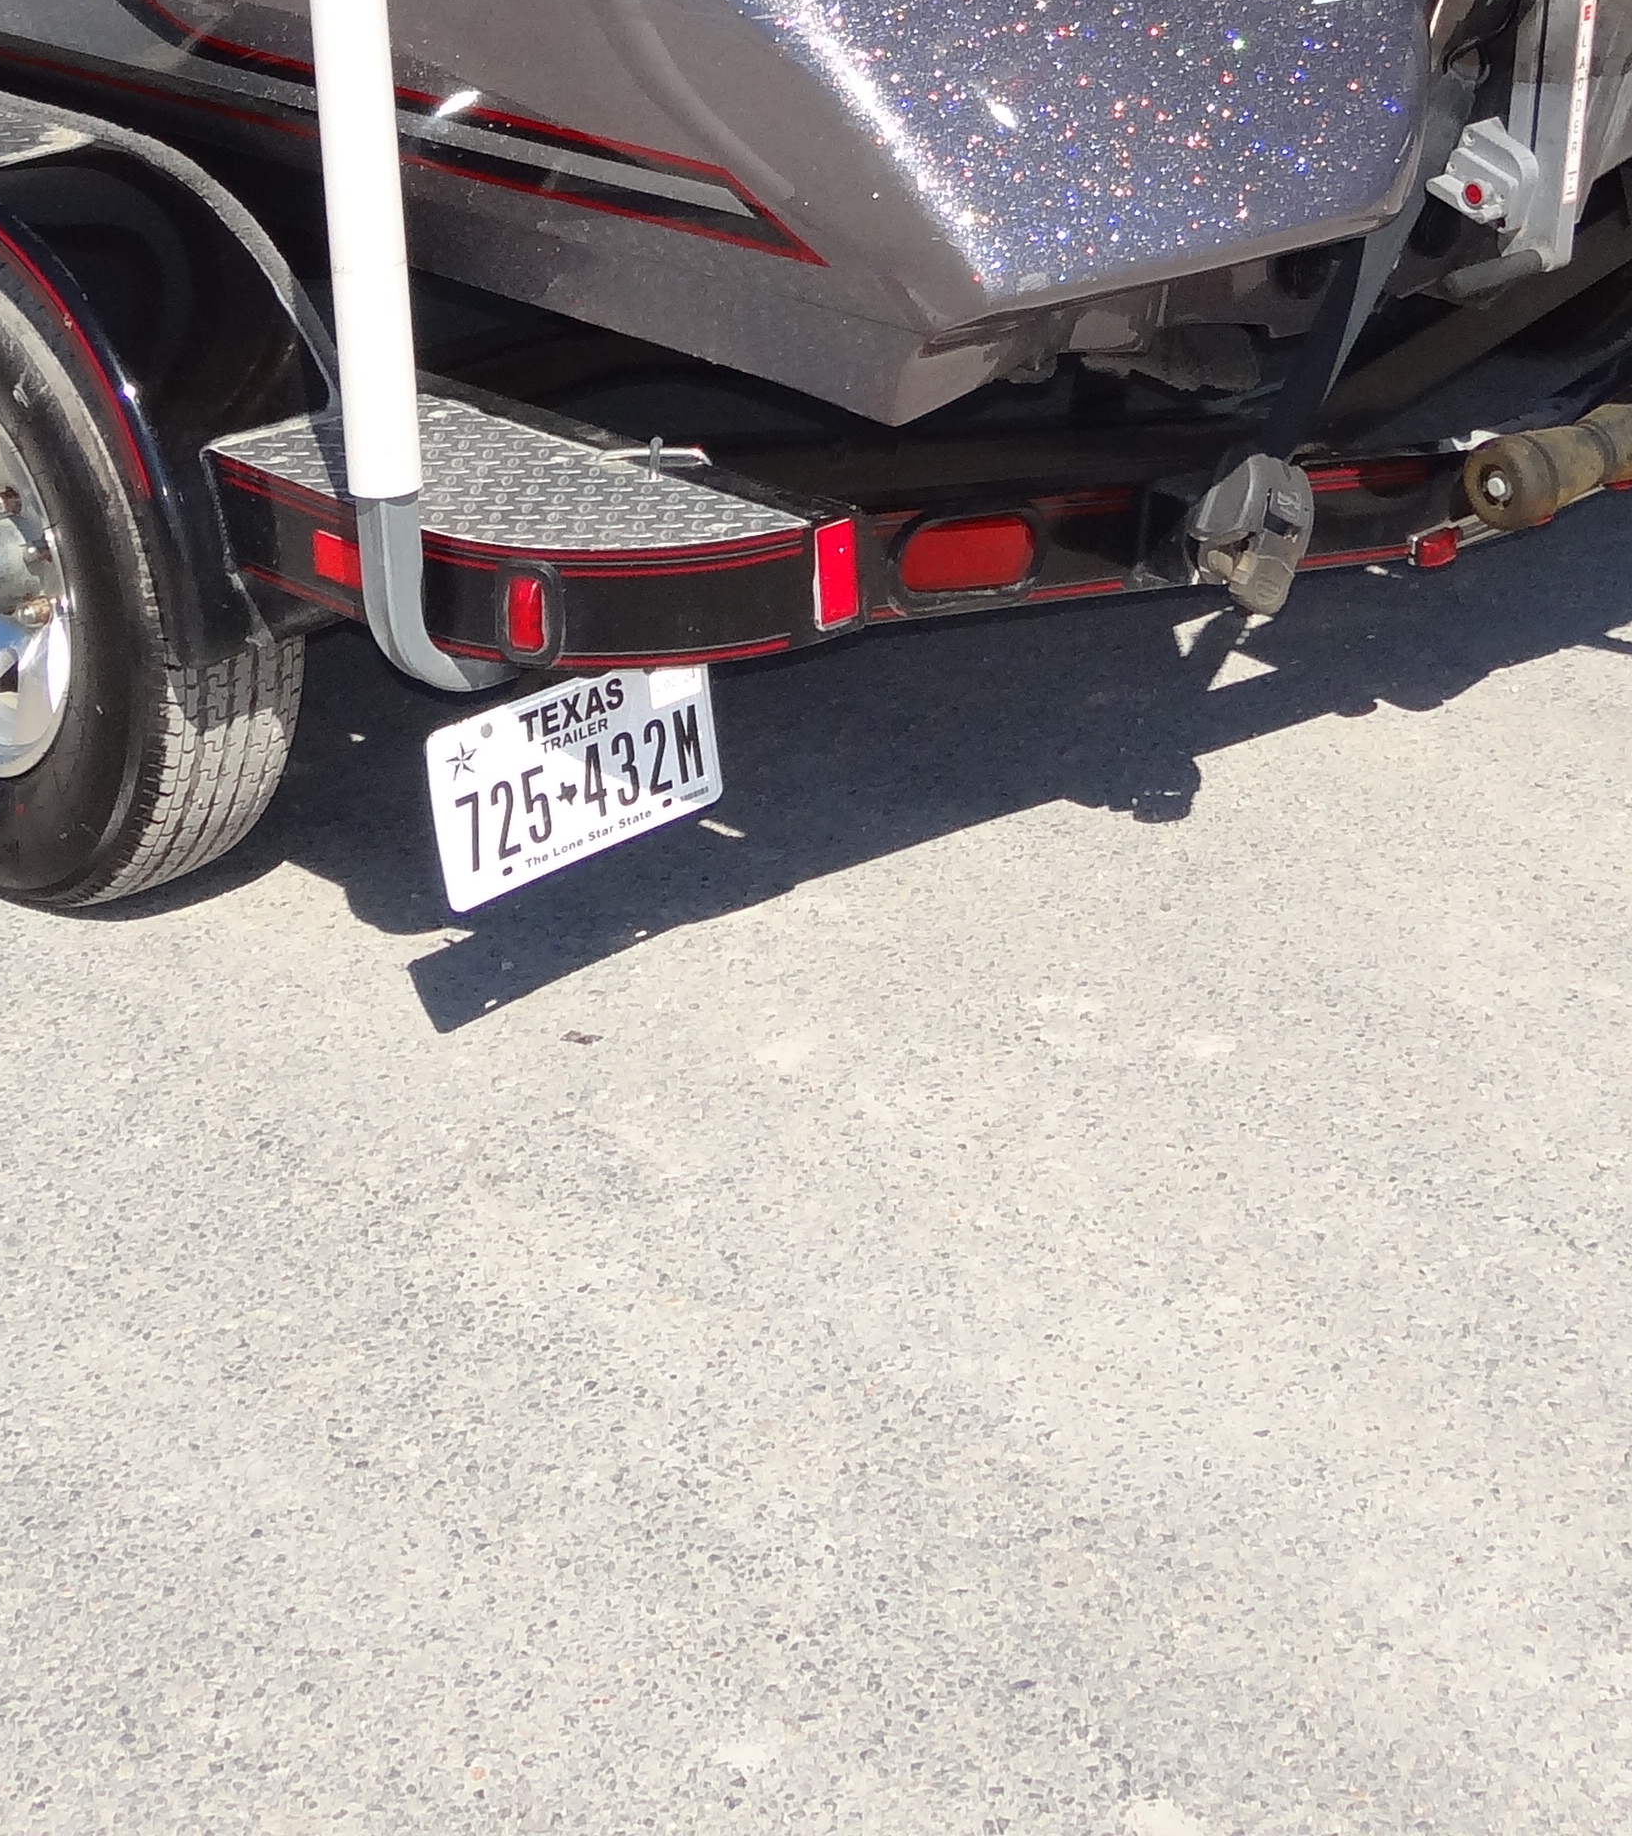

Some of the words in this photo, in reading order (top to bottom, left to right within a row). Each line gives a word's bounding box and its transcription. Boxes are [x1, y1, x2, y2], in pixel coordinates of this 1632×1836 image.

[519, 678, 624, 742] TEXAS
[541, 717, 609, 754] TRAILER
[525, 851, 549, 869] The
[553, 837, 584, 857] Lone
[588, 824, 614, 842] Star
[618, 809, 652, 829] State
